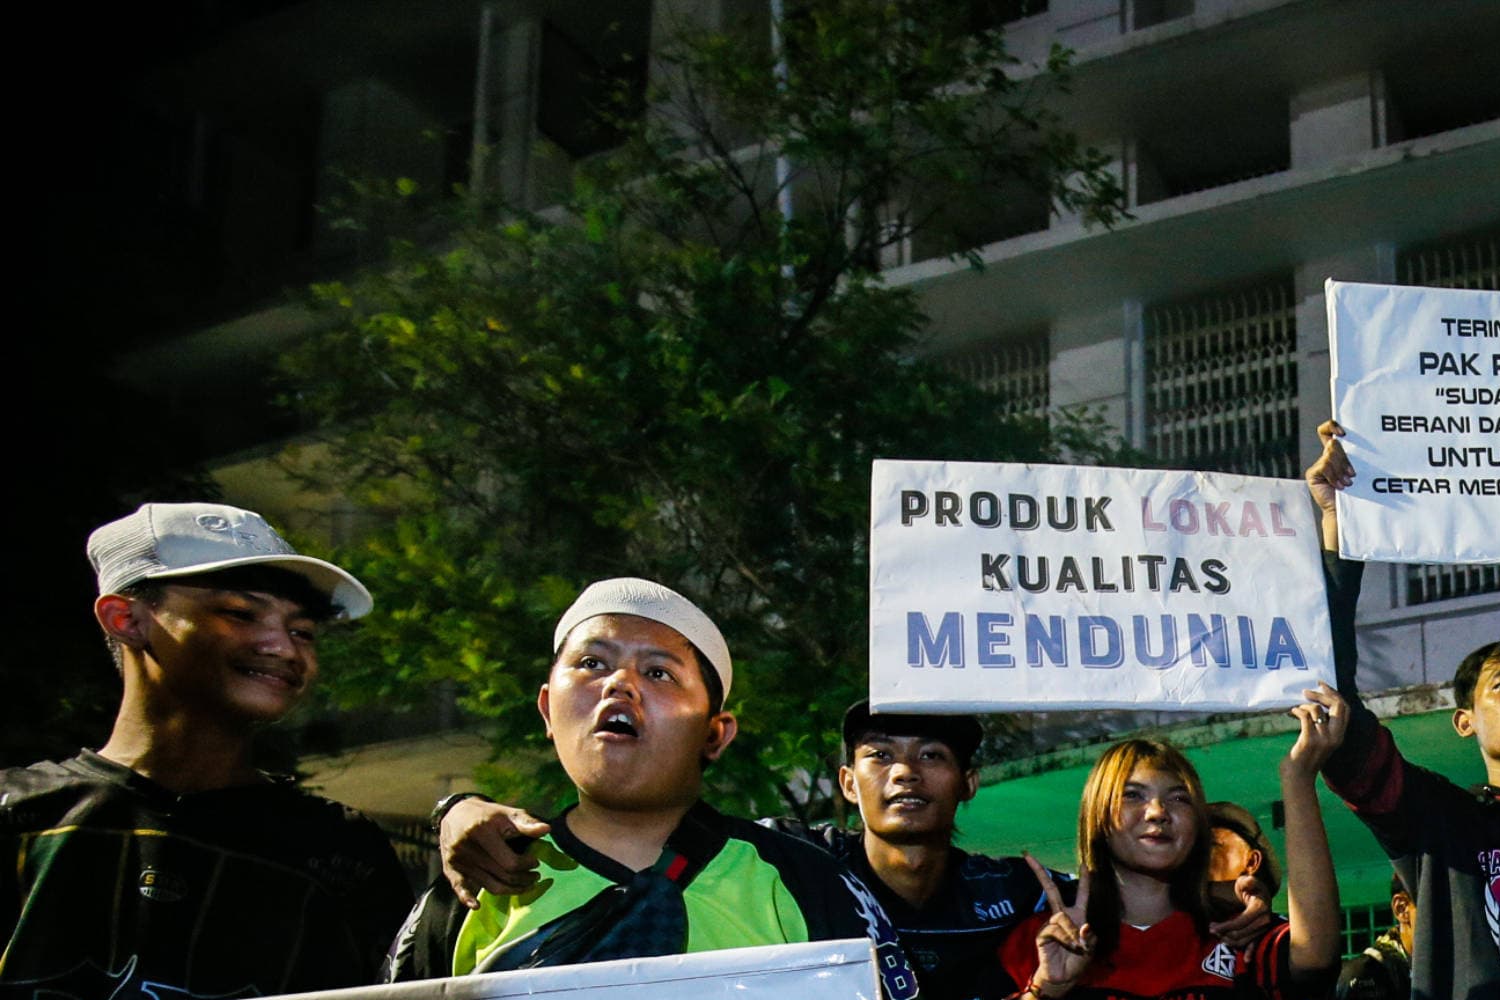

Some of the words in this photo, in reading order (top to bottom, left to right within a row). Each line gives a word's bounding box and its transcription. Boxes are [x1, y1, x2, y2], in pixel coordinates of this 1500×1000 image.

[1419, 352, 1482, 376] PAK
[1380, 415, 1470, 433] BERANI
[1370, 477, 1451, 496] CETAR
[900, 489, 1115, 532] PRODUK
[1142, 497, 1296, 537] LOKAL
[981, 553, 1231, 595] KUALITAS
[906, 611, 1309, 671] MENDUNIA
